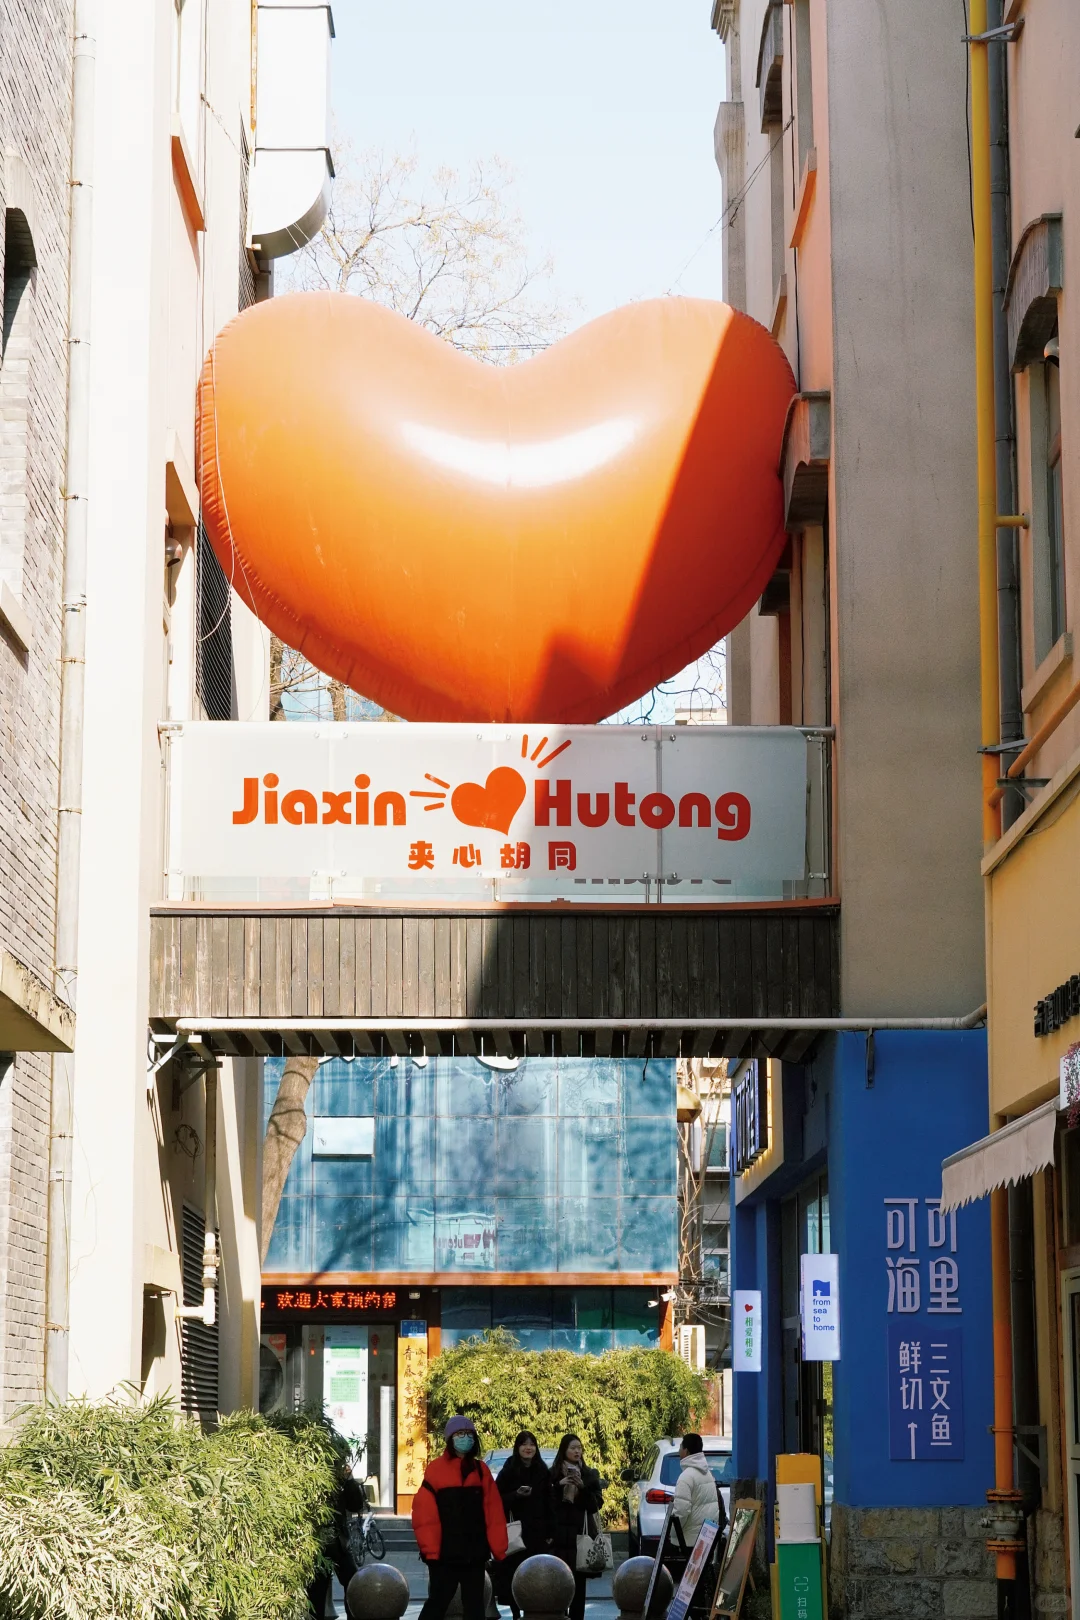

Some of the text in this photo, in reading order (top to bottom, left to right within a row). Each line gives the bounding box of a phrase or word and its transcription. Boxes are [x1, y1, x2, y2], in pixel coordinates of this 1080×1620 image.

[232, 772, 752, 842] Jiaxin Hutong
[407, 840, 577, 872] 夹心胡同
[812, 1298, 831, 1306] from
[813, 1315, 821, 1323] to
[813, 1323, 835, 1331] home
[899, 1341, 923, 1410] 鲜切
[929, 1343, 953, 1446] 三文鱼
